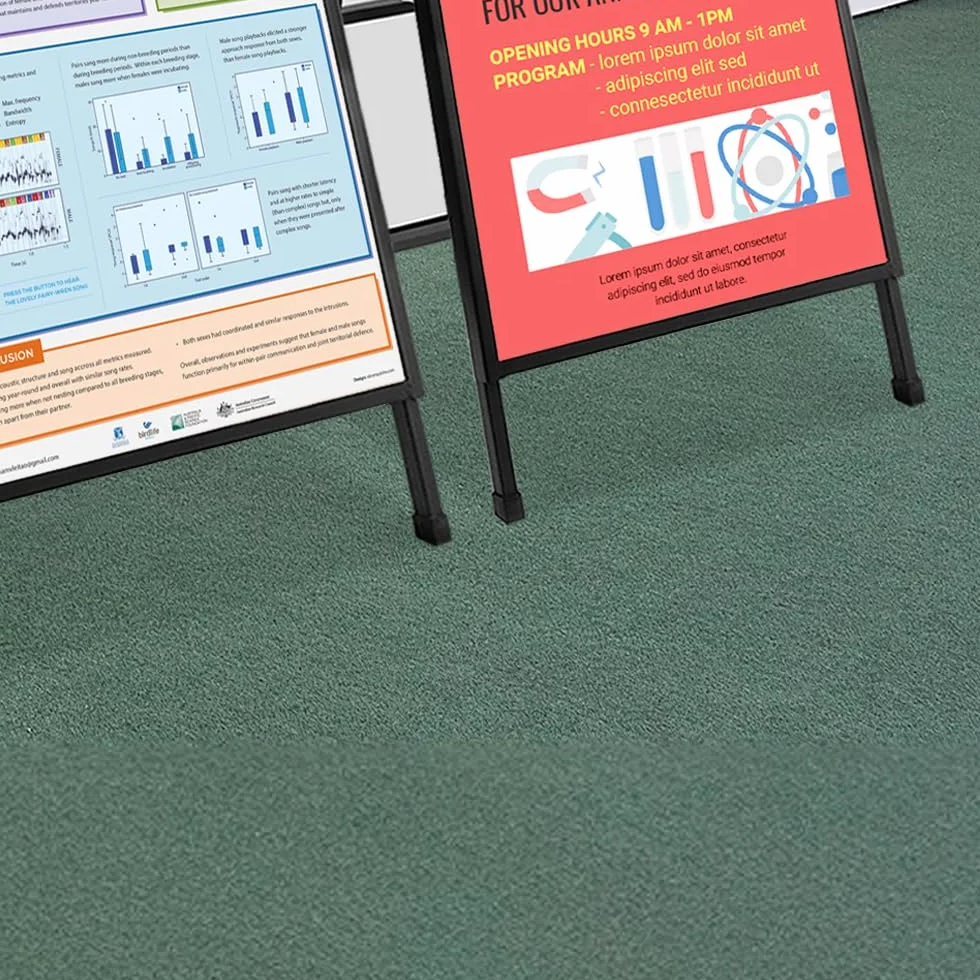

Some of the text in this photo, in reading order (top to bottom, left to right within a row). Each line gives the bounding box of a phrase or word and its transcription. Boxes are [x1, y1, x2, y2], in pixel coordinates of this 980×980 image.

[489, 7, 732, 64] OPENING HOURS 9 AM 1PM
[493, 17, 806, 89] PROGRAM lorem ipsum dolor sit amet
[605, 51, 746, 92] adipiscing elit sed
[609, 61, 819, 117] connesectetur incididunt ut
[599, 231, 786, 284] Lorem ipsum dolor sit amet, consectetur
[607, 248, 785, 300] adipiscing elit, sed do eiusmod tempor
[655, 285, 701, 304] incididunt
[703, 283, 713, 293] ut
